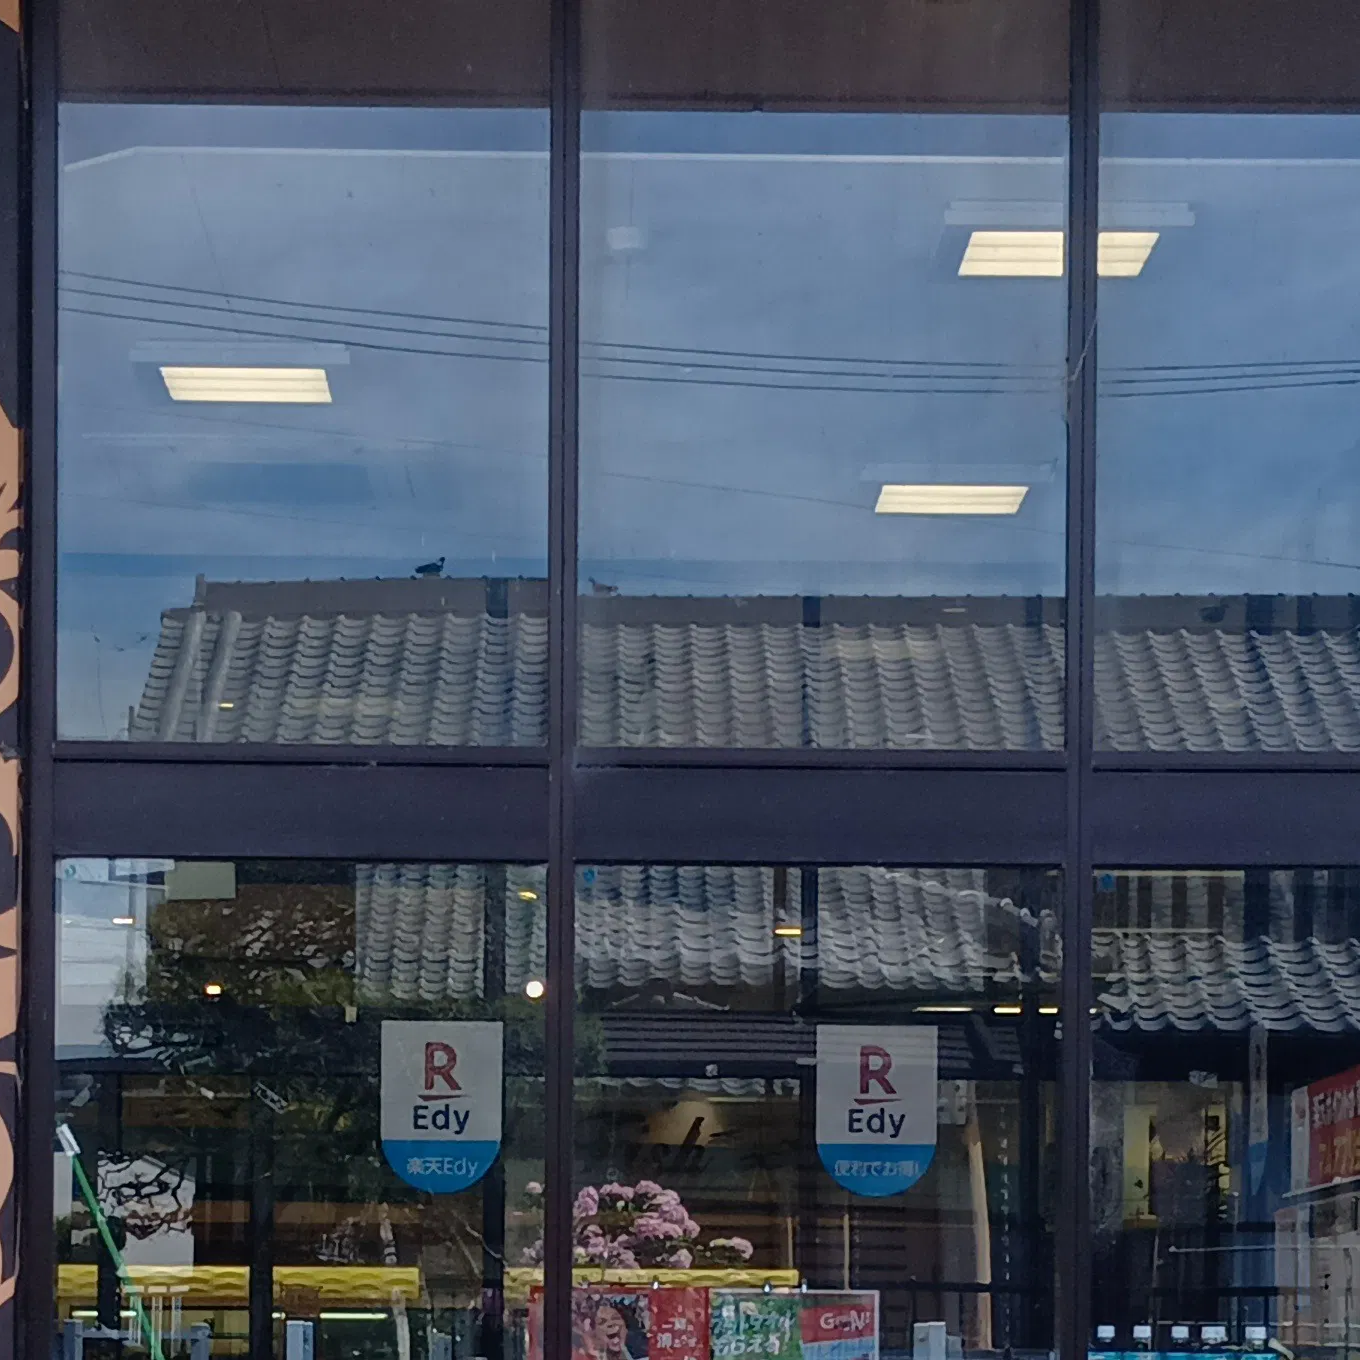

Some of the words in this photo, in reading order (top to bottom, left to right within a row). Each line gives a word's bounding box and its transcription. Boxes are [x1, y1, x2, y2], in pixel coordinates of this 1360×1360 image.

[424, 1041, 462, 1091] R
[859, 1045, 897, 1094] R
[412, 1104, 470, 1135] Edy
[848, 1108, 906, 1139] Edy
